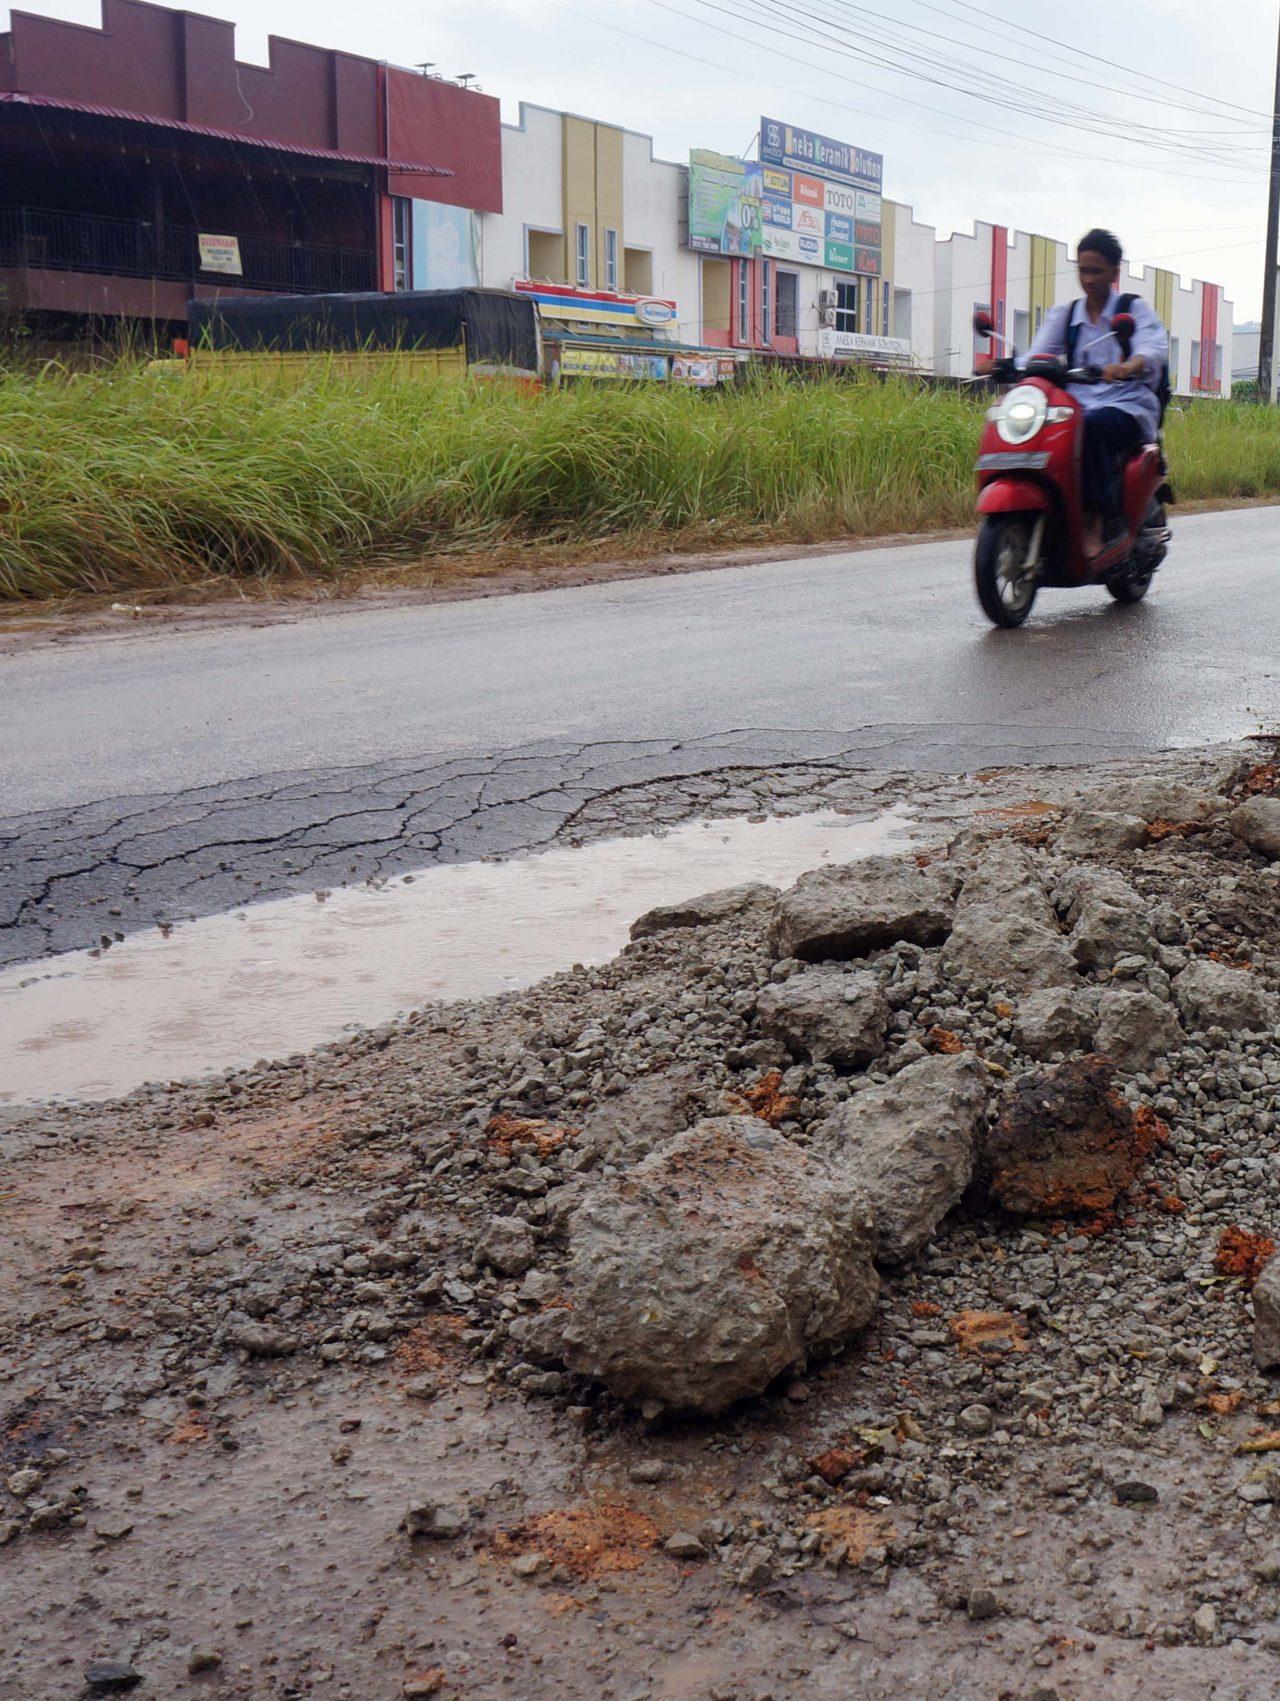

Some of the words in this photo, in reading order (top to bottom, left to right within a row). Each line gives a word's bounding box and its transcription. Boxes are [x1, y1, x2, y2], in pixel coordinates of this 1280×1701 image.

[814, 137, 848, 169] Keramik
[849, 147, 881, 179] Solution
[826, 190, 853, 210] TOTO
